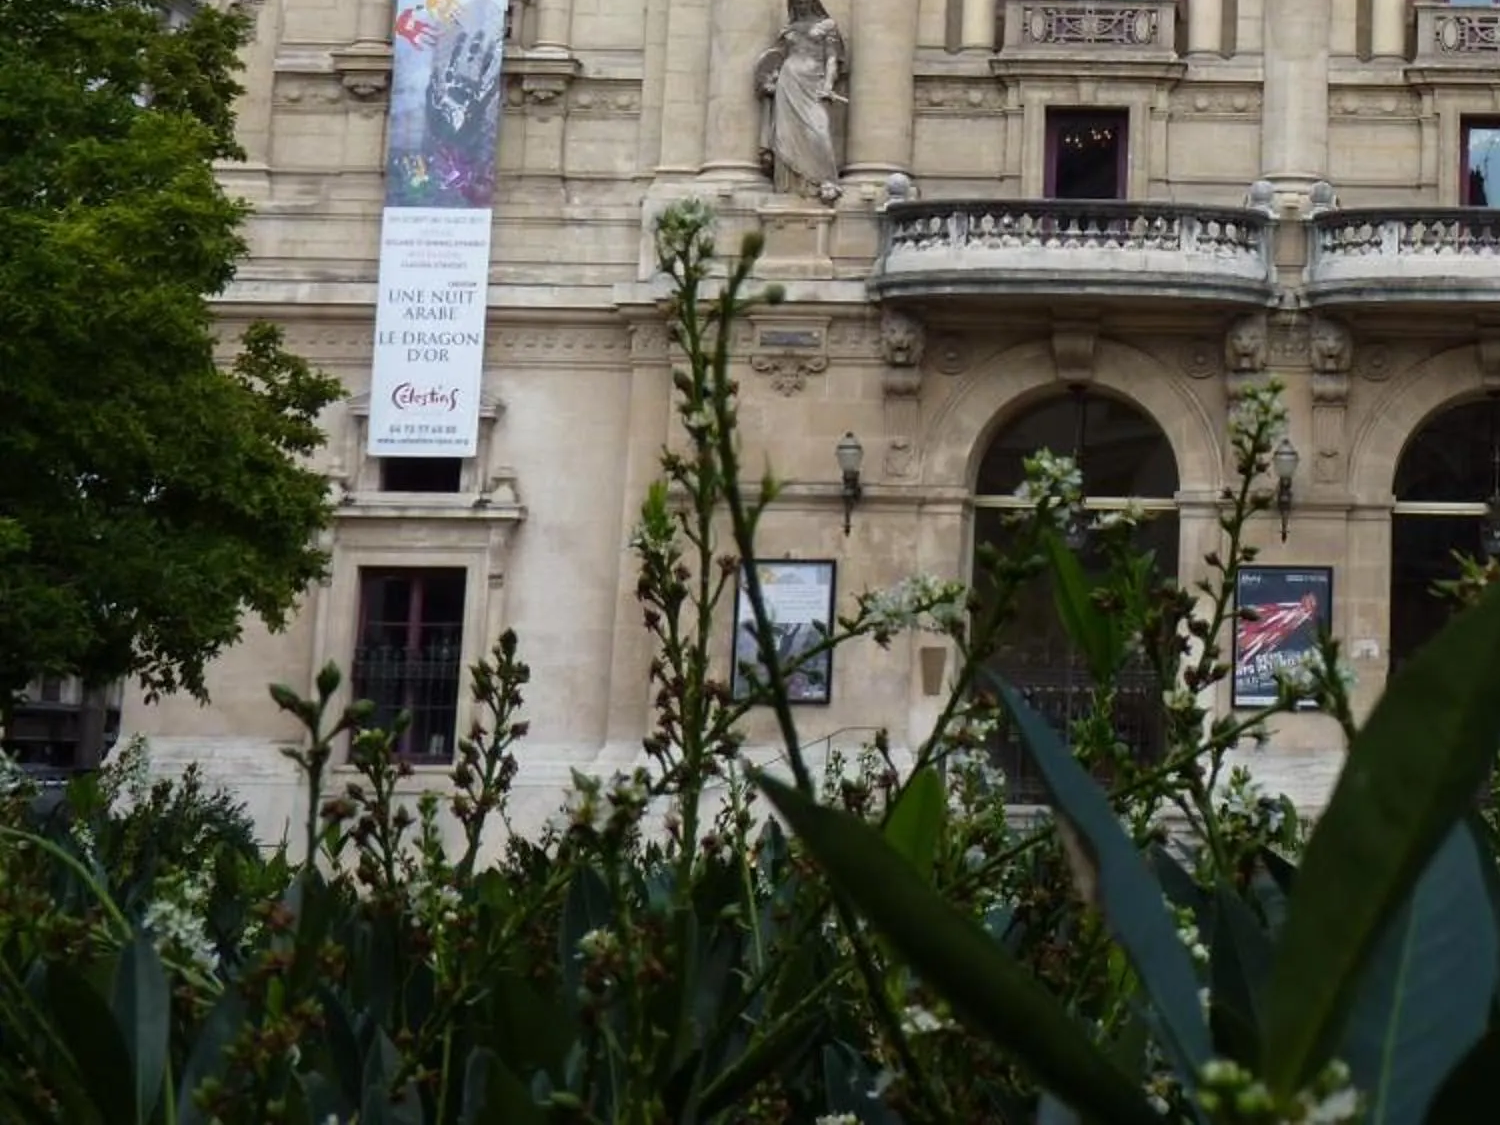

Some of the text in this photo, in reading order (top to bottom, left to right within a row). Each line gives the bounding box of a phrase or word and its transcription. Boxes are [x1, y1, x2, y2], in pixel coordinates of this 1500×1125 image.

[388, 289, 477, 305] UNE NUIT
[403, 306, 457, 321] ARABE
[379, 331, 480, 346] LE DRAGON
[407, 348, 449, 363] D'OR
